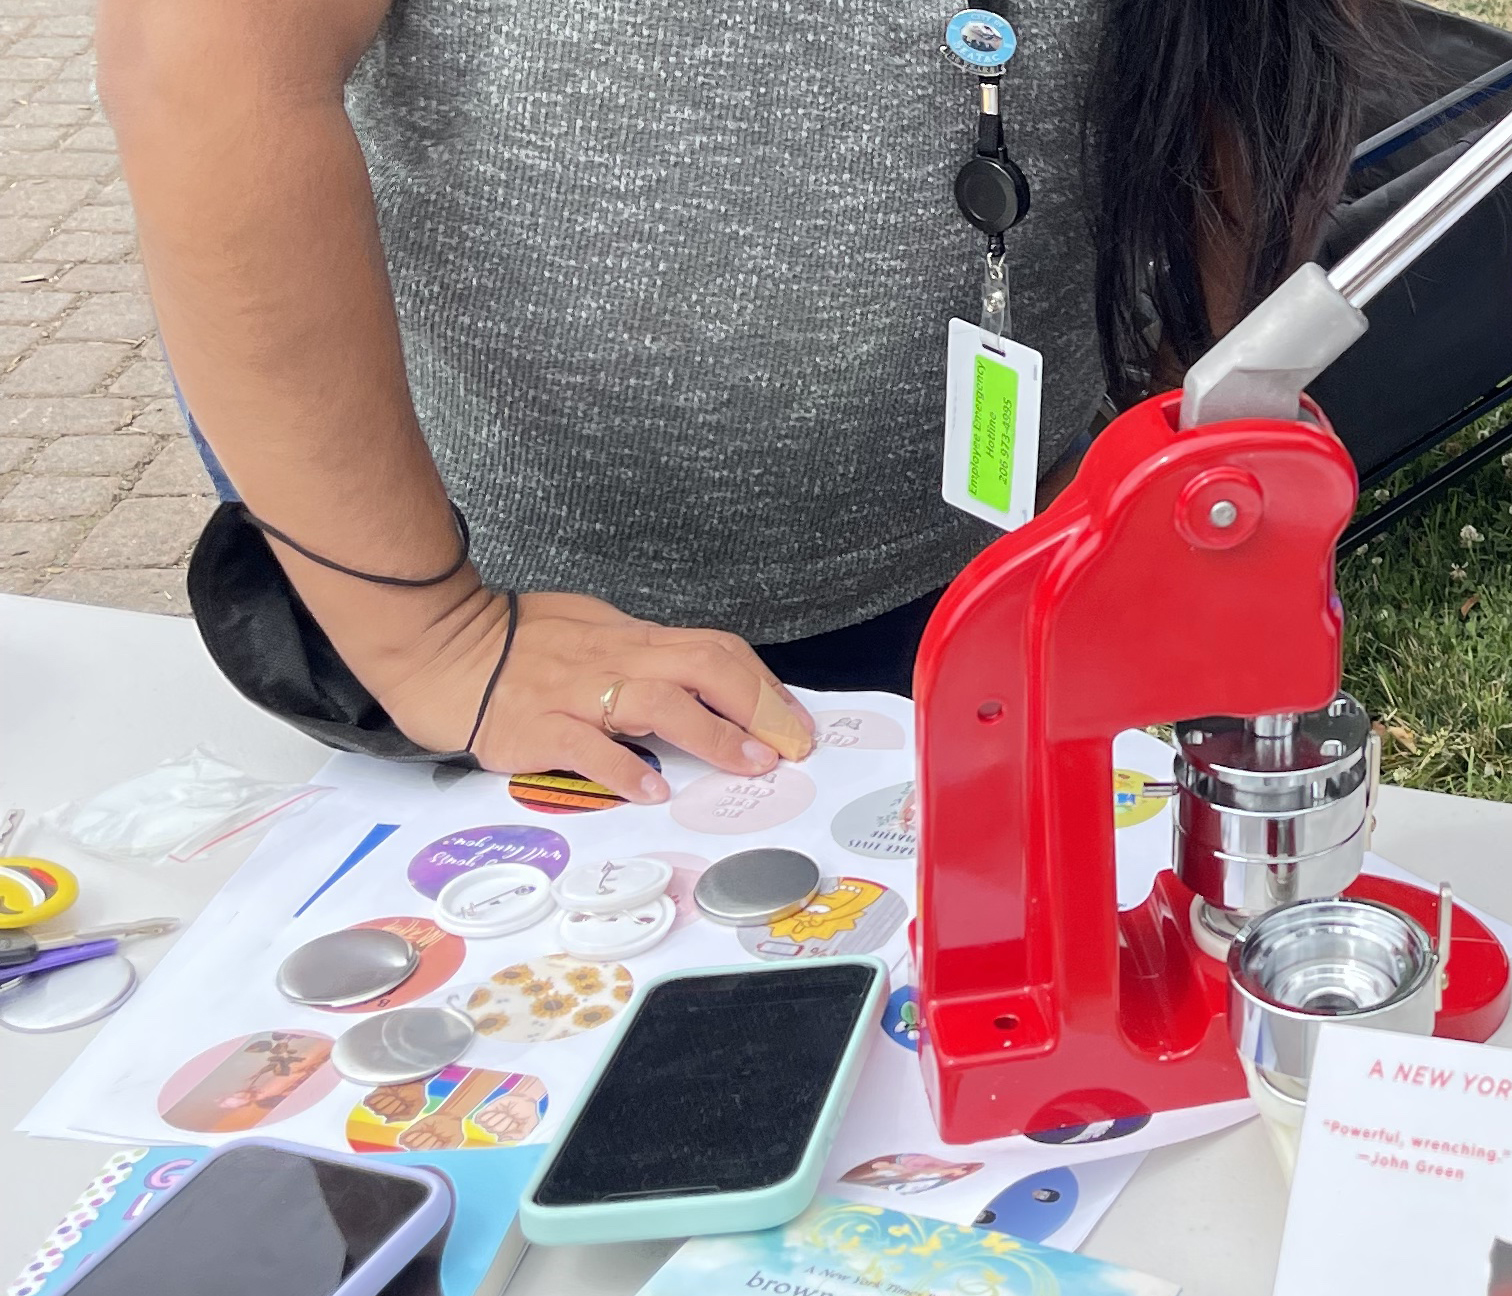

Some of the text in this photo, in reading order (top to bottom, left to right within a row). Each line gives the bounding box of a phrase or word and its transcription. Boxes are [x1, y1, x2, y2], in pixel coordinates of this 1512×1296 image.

[968, 360, 987, 496] Employee Emergency
[985, 412, 998, 459] Hotline
[998, 460, 1009, 486] 206
[886, 844, 915, 856] LACK
[1368, 1058, 1386, 1080] A
[1392, 1061, 1454, 1091] NEW
[1414, 1160, 1466, 1181] Green
[818, 1267, 852, 1282] New
[854, 1274, 882, 1290] York
